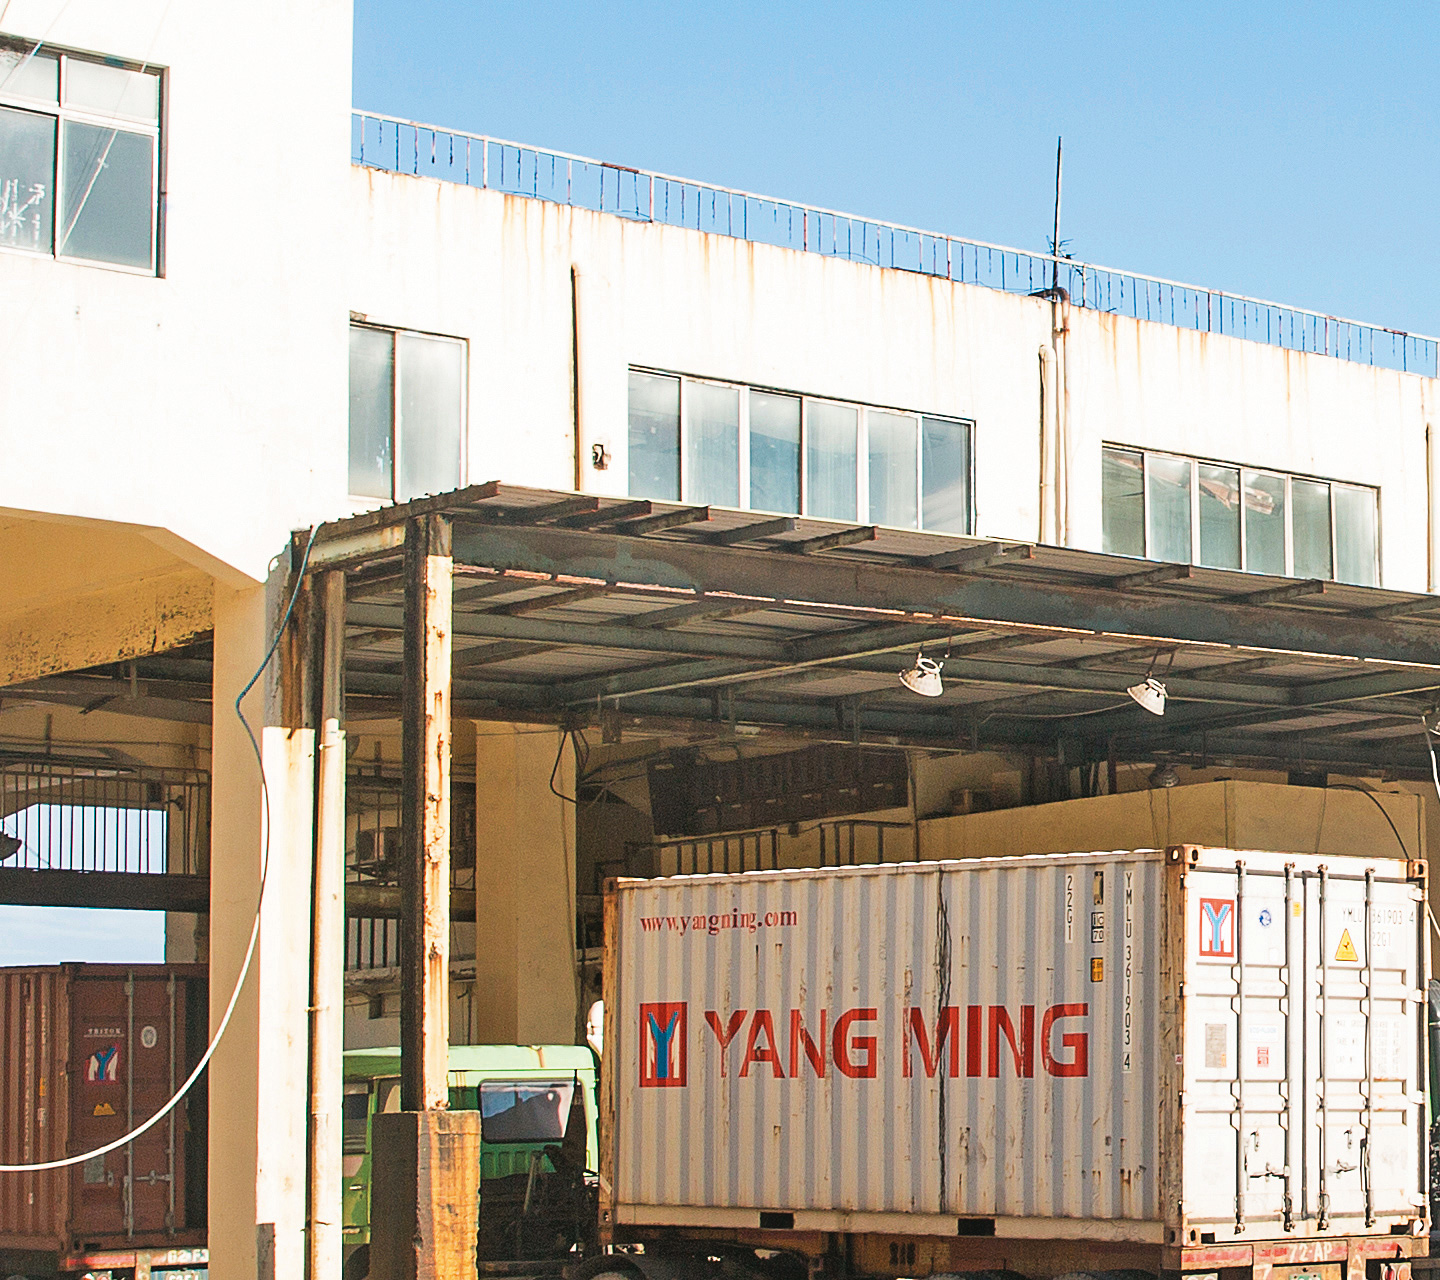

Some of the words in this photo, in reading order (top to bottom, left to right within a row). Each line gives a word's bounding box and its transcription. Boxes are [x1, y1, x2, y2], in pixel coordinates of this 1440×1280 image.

[1125, 871, 1133, 939] YMLU
[703, 1007, 878, 1079] YANG
[902, 1002, 1089, 1079] MING
